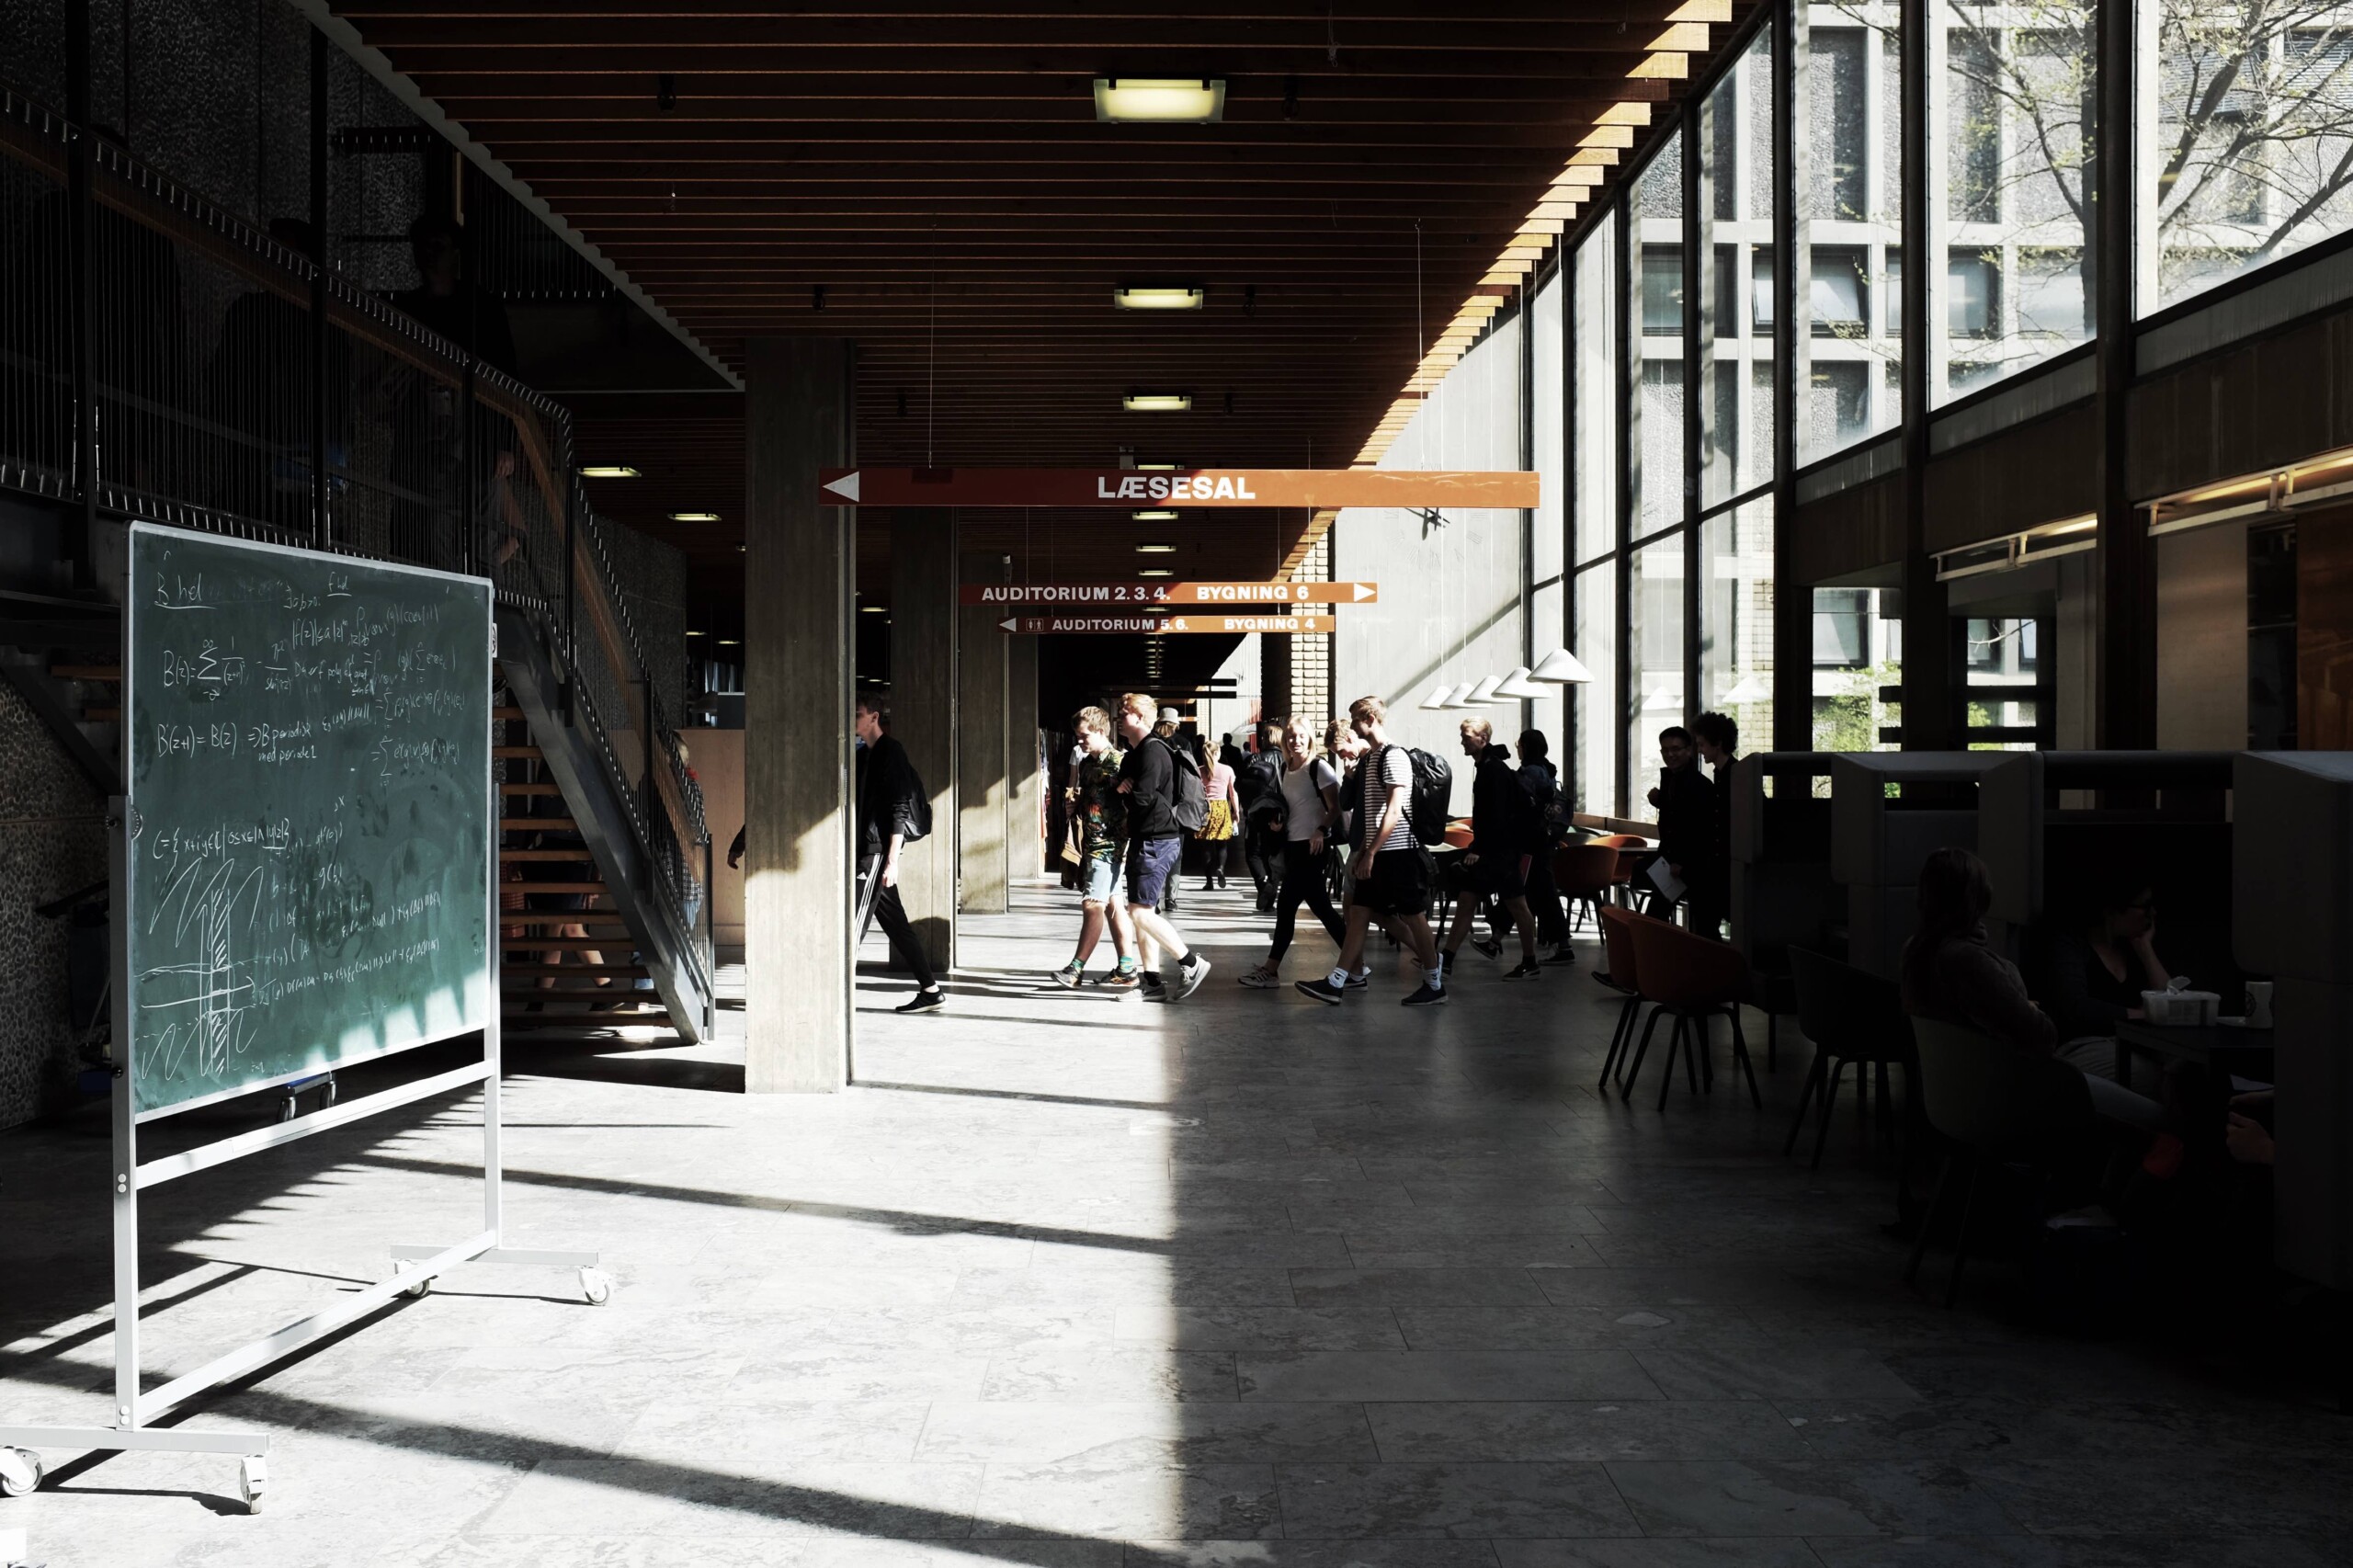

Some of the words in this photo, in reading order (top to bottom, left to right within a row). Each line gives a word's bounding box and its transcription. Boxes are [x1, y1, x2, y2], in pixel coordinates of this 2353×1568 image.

[1097, 476, 1256, 500] LÆSESAL
[982, 586, 1109, 601] AUDITORIUM
[1197, 585, 1288, 600] BYGNING
[1297, 585, 1309, 600] 6
[1051, 619, 1154, 631] AUDITORIUM
[1224, 619, 1299, 631] BYGNING
[1304, 619, 1315, 631] 4
